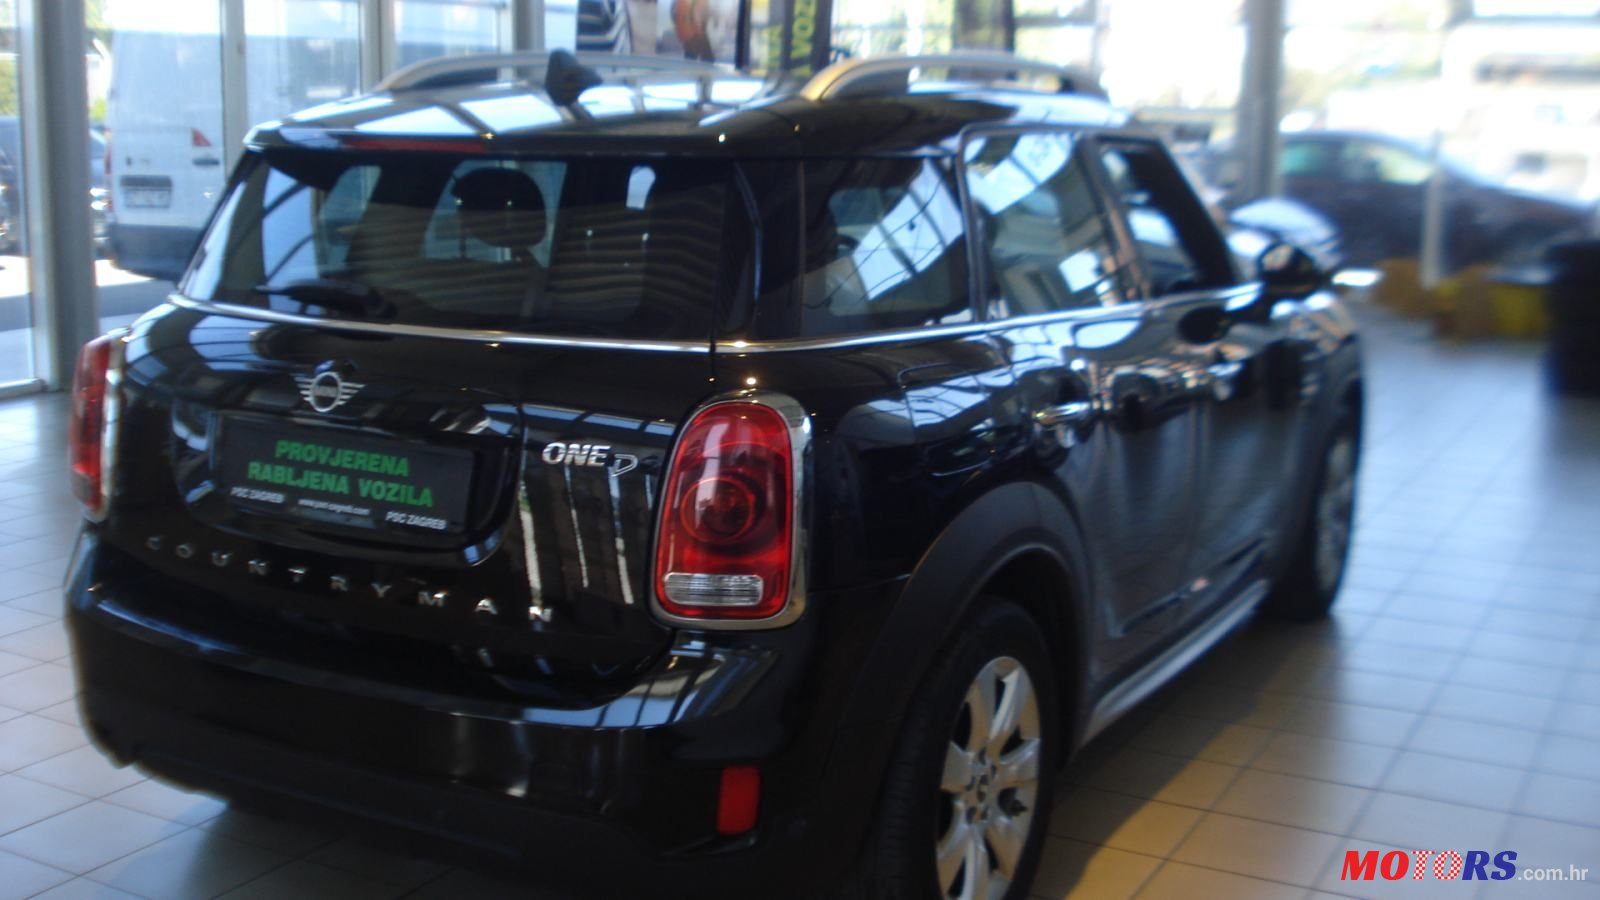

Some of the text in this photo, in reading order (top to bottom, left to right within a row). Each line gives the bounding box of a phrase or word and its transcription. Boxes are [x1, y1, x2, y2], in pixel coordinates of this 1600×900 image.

[275, 439, 410, 477] PROVJERENA
[542, 442, 611, 466] ONE
[247, 461, 434, 508] RABLJENA VOZILA
[406, 514, 447, 530] ZAGREB
[144, 534, 555, 624] COUNTRYMAN
